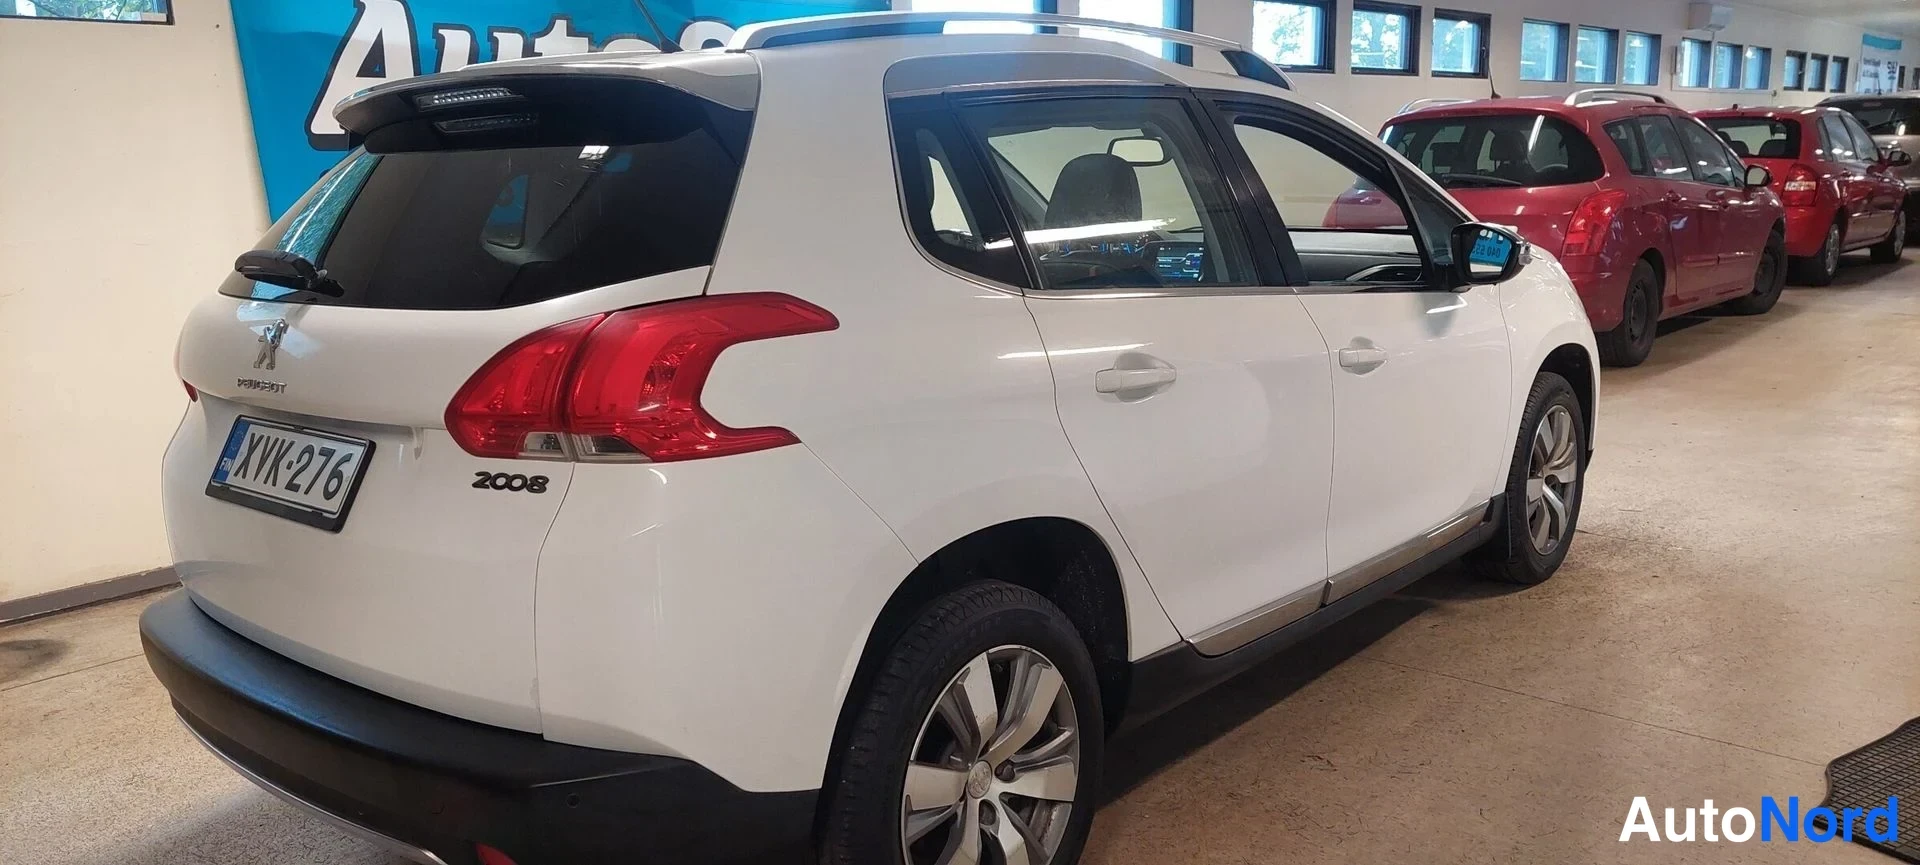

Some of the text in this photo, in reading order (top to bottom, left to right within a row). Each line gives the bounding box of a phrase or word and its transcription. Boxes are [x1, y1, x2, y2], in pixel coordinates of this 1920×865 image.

[237, 377, 287, 394] PEUGEOT
[219, 457, 234, 471] FIN
[233, 432, 355, 501] XVK-276
[472, 471, 550, 494] 2008
